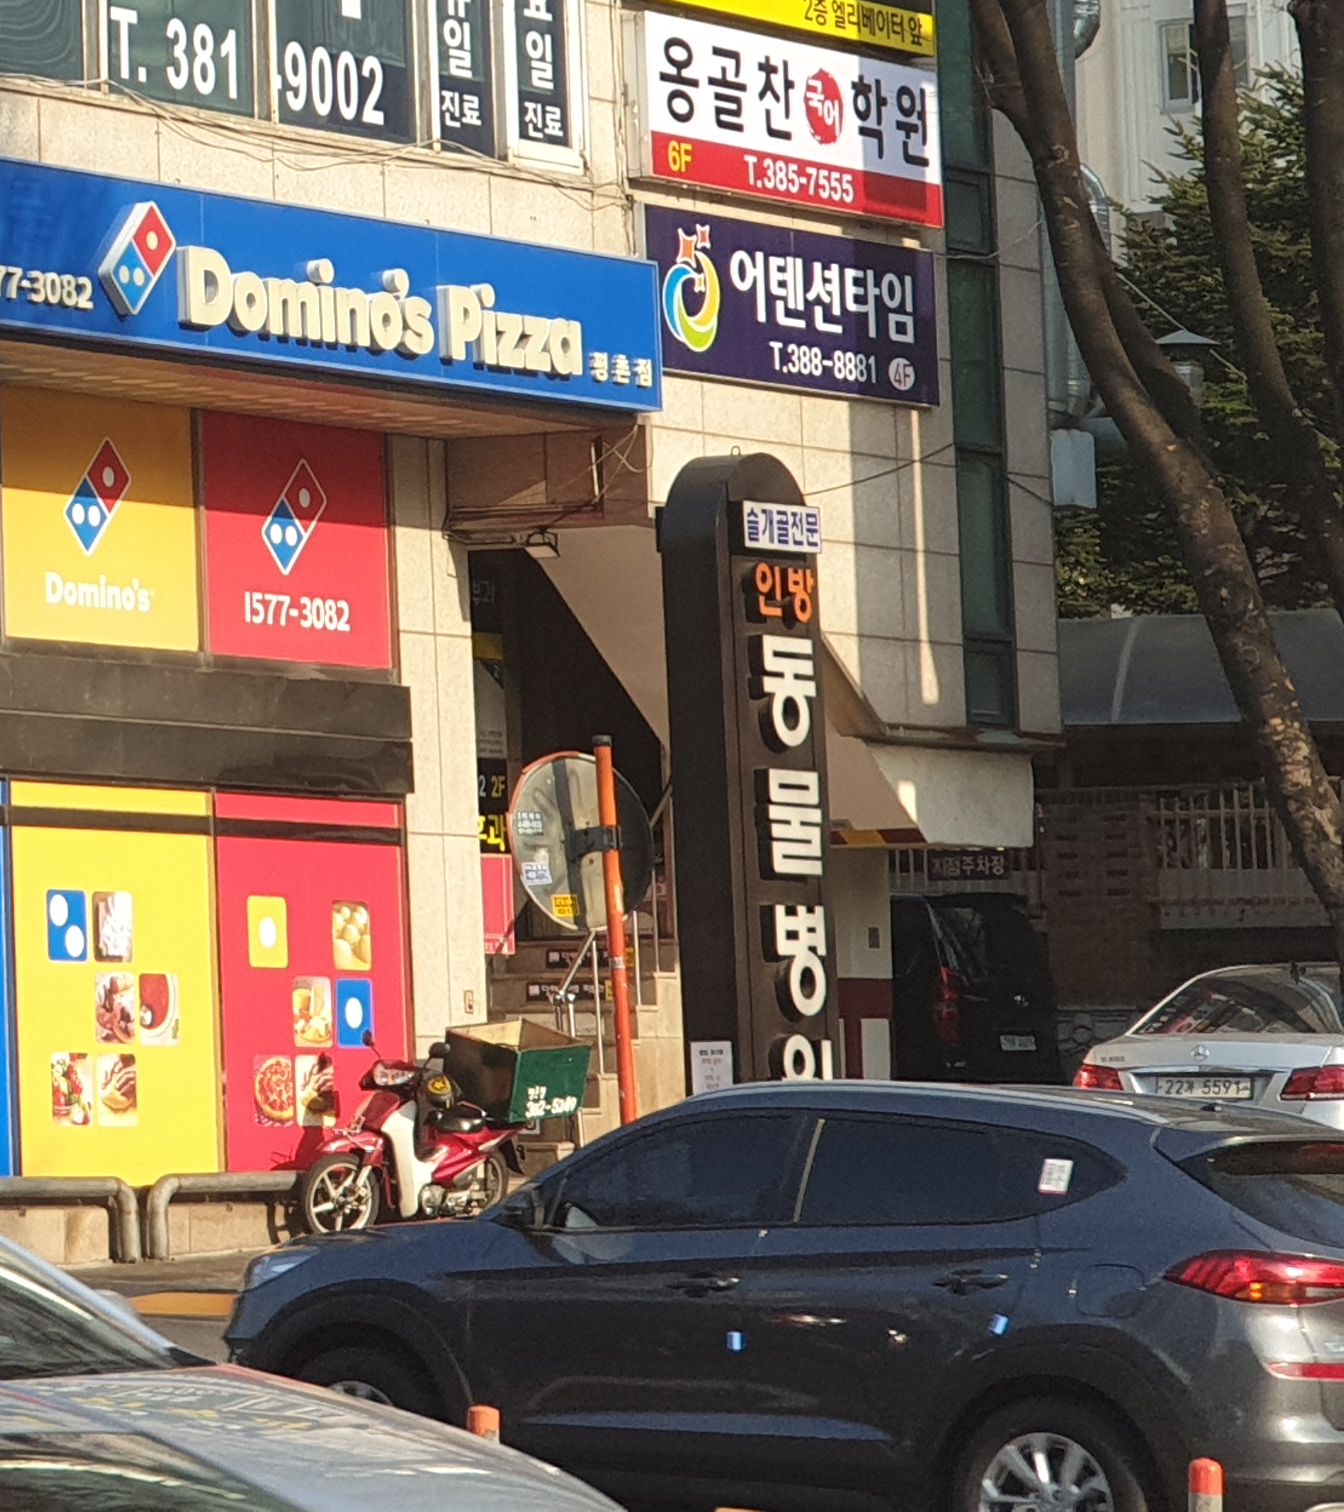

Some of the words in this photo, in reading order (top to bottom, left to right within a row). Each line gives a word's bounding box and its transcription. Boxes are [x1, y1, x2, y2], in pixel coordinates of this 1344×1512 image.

[831, 1, 904, 43] 엘리베이터
[907, 17, 924, 48] 앞
[440, 90, 482, 130] 진료
[524, 101, 564, 139] 진료
[658, 35, 796, 142] 옹골찬
[805, 79, 842, 139] 국어
[851, 72, 931, 168] 학원
[667, 140, 693, 173] 6F
[743, 153, 855, 204] T.385-7555
[175, 243, 434, 359] Domino's
[437, 283, 584, 378] Pizza
[589, 351, 654, 389] 평촌점
[729, 249, 916, 345] 어텐션타임
[770, 340, 878, 384] T.388-8881
[892, 362, 912, 388] 4F
[745, 504, 820, 549] 슬개골전문
[43, 570, 154, 614] Domino's
[243, 590, 352, 633] 1577-3082
